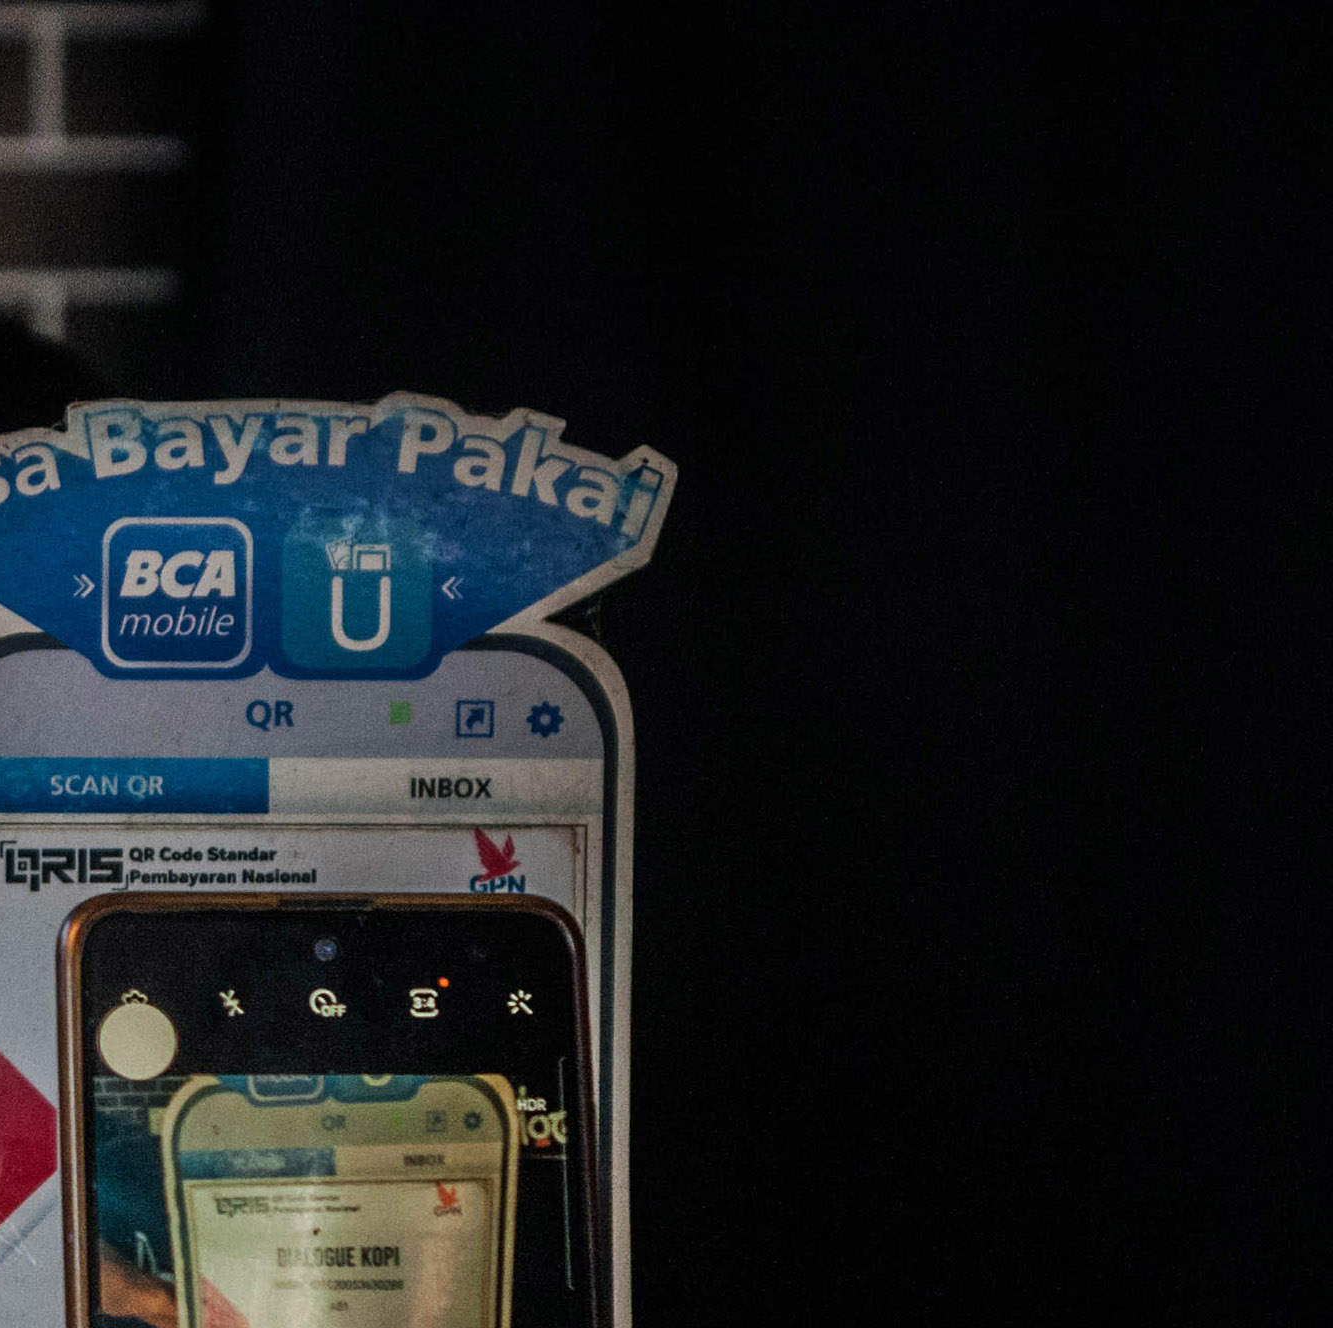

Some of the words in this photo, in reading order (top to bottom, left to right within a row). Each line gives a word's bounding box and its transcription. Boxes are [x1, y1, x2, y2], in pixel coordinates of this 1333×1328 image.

[86, 404, 369, 485] Bayar
[396, 407, 666, 542] Pakai
[120, 548, 237, 599] BCA
[118, 607, 235, 637] mobile
[245, 699, 295, 732] QR
[49, 774, 119, 797] SCAN
[127, 774, 164, 799] QR
[409, 777, 492, 799] INBOX
[128, 847, 156, 863] QR
[159, 847, 203, 863] Code
[207, 846, 278, 863] Standar
[3, 845, 125, 892] QRIS
[129, 869, 237, 887] Pembayaran
[241, 868, 318, 885] Nasional
[469, 873, 526, 894] GPN
[320, 1004, 347, 1018] OFF
[517, 1097, 547, 1112] HDR
[360, 1246, 401, 1268] KOPI
